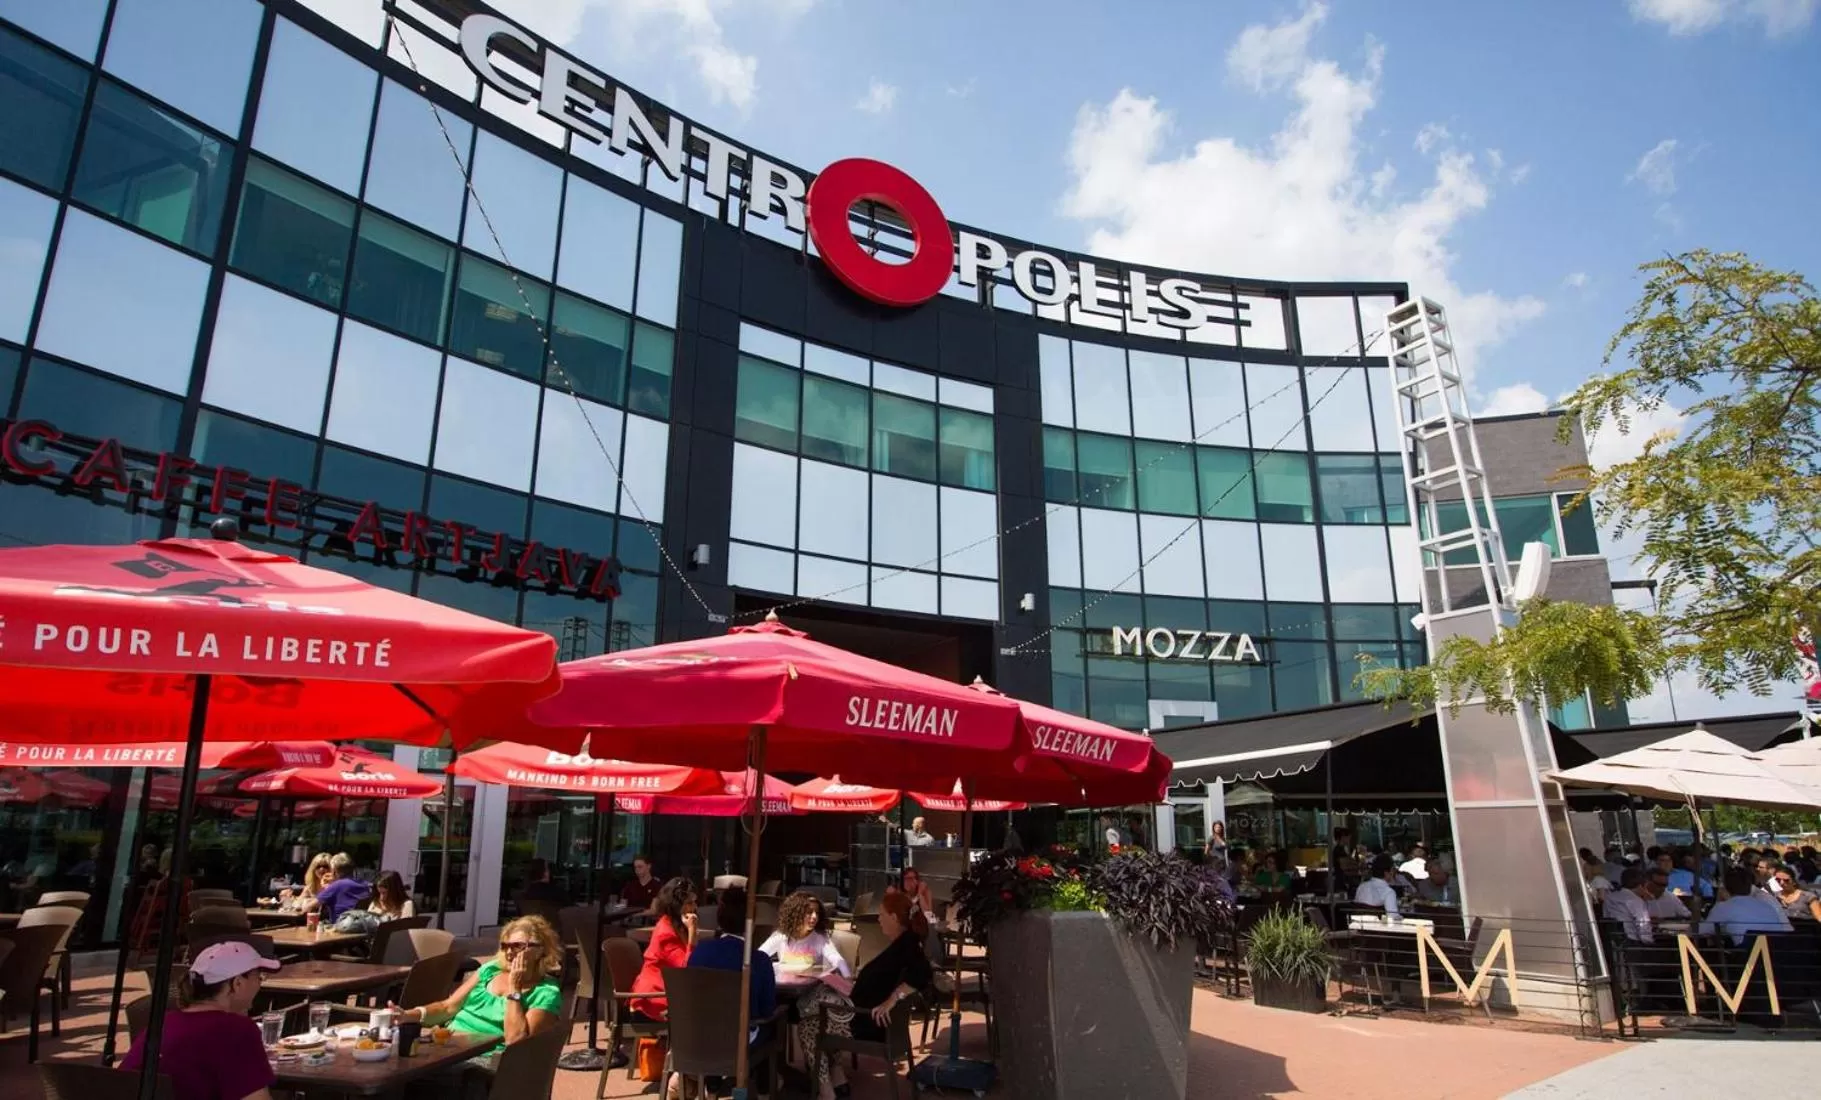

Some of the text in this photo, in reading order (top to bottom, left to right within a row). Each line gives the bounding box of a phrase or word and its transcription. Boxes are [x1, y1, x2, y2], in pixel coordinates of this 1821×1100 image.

[2, 418, 624, 599] CAFFE ARTJAVA
[34, 623, 152, 656] POUR
[176, 632, 220, 659] LA
[242, 635, 393, 668] LIBERTÉ
[1112, 625, 1261, 662] MOZZA
[845, 696, 959, 737] SLEEMAN
[16, 746, 65, 760] POUR
[73, 748, 95, 761] LA
[103, 746, 177, 763] LIBERTÉ
[1034, 725, 1117, 762] SLEEMAN
[507, 768, 660, 788] MANKIND IS BORN FREE
[1416, 926, 1519, 1006] M
[1677, 934, 1780, 1015] M
